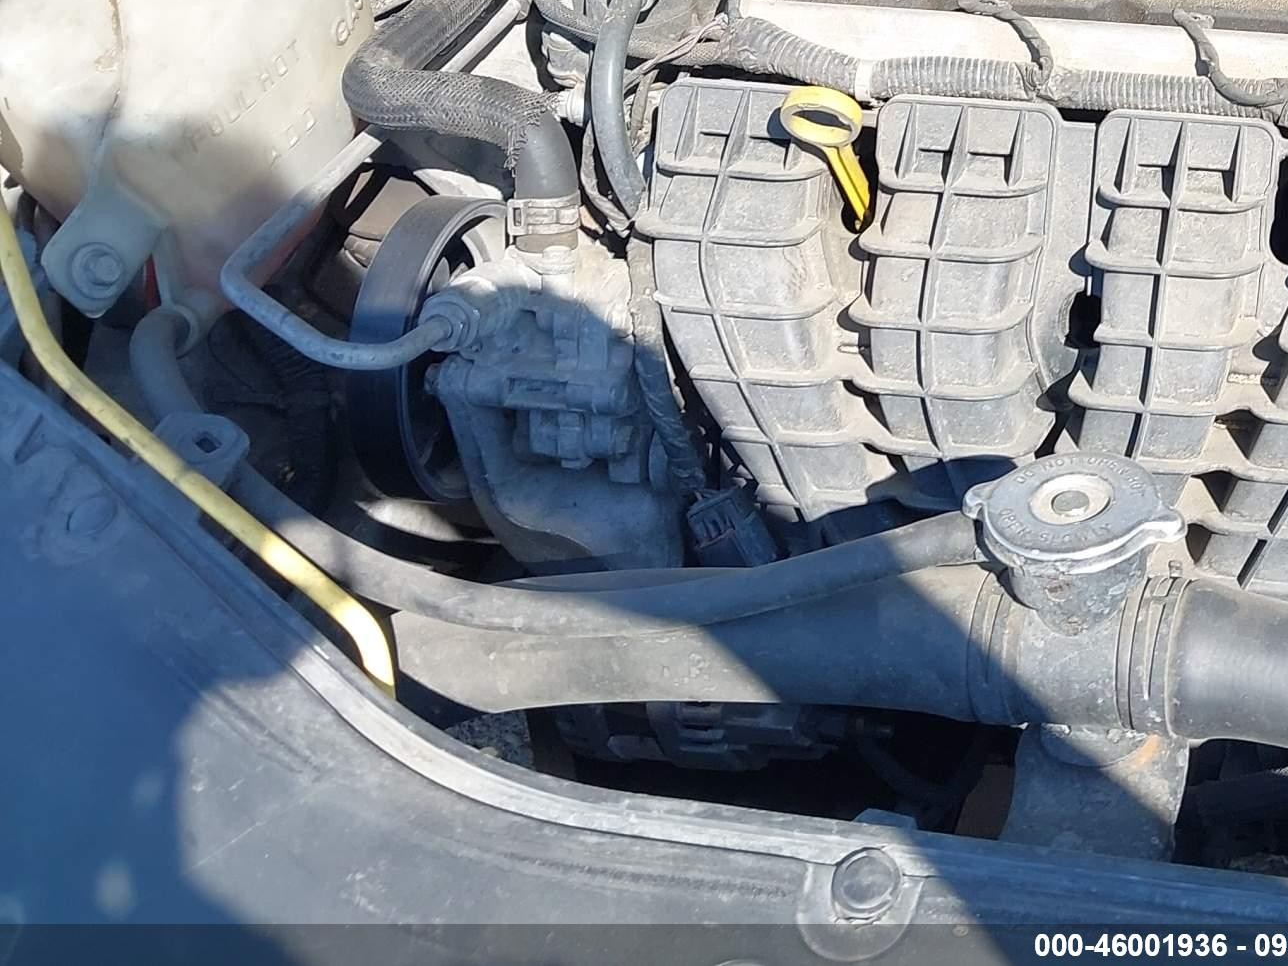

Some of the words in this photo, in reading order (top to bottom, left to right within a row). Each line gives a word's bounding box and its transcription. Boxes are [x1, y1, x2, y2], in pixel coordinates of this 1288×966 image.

[1041, 457, 1077, 470] NOT
[1087, 456, 1128, 476] OPEN
[1000, 508, 1032, 536] OPEN
